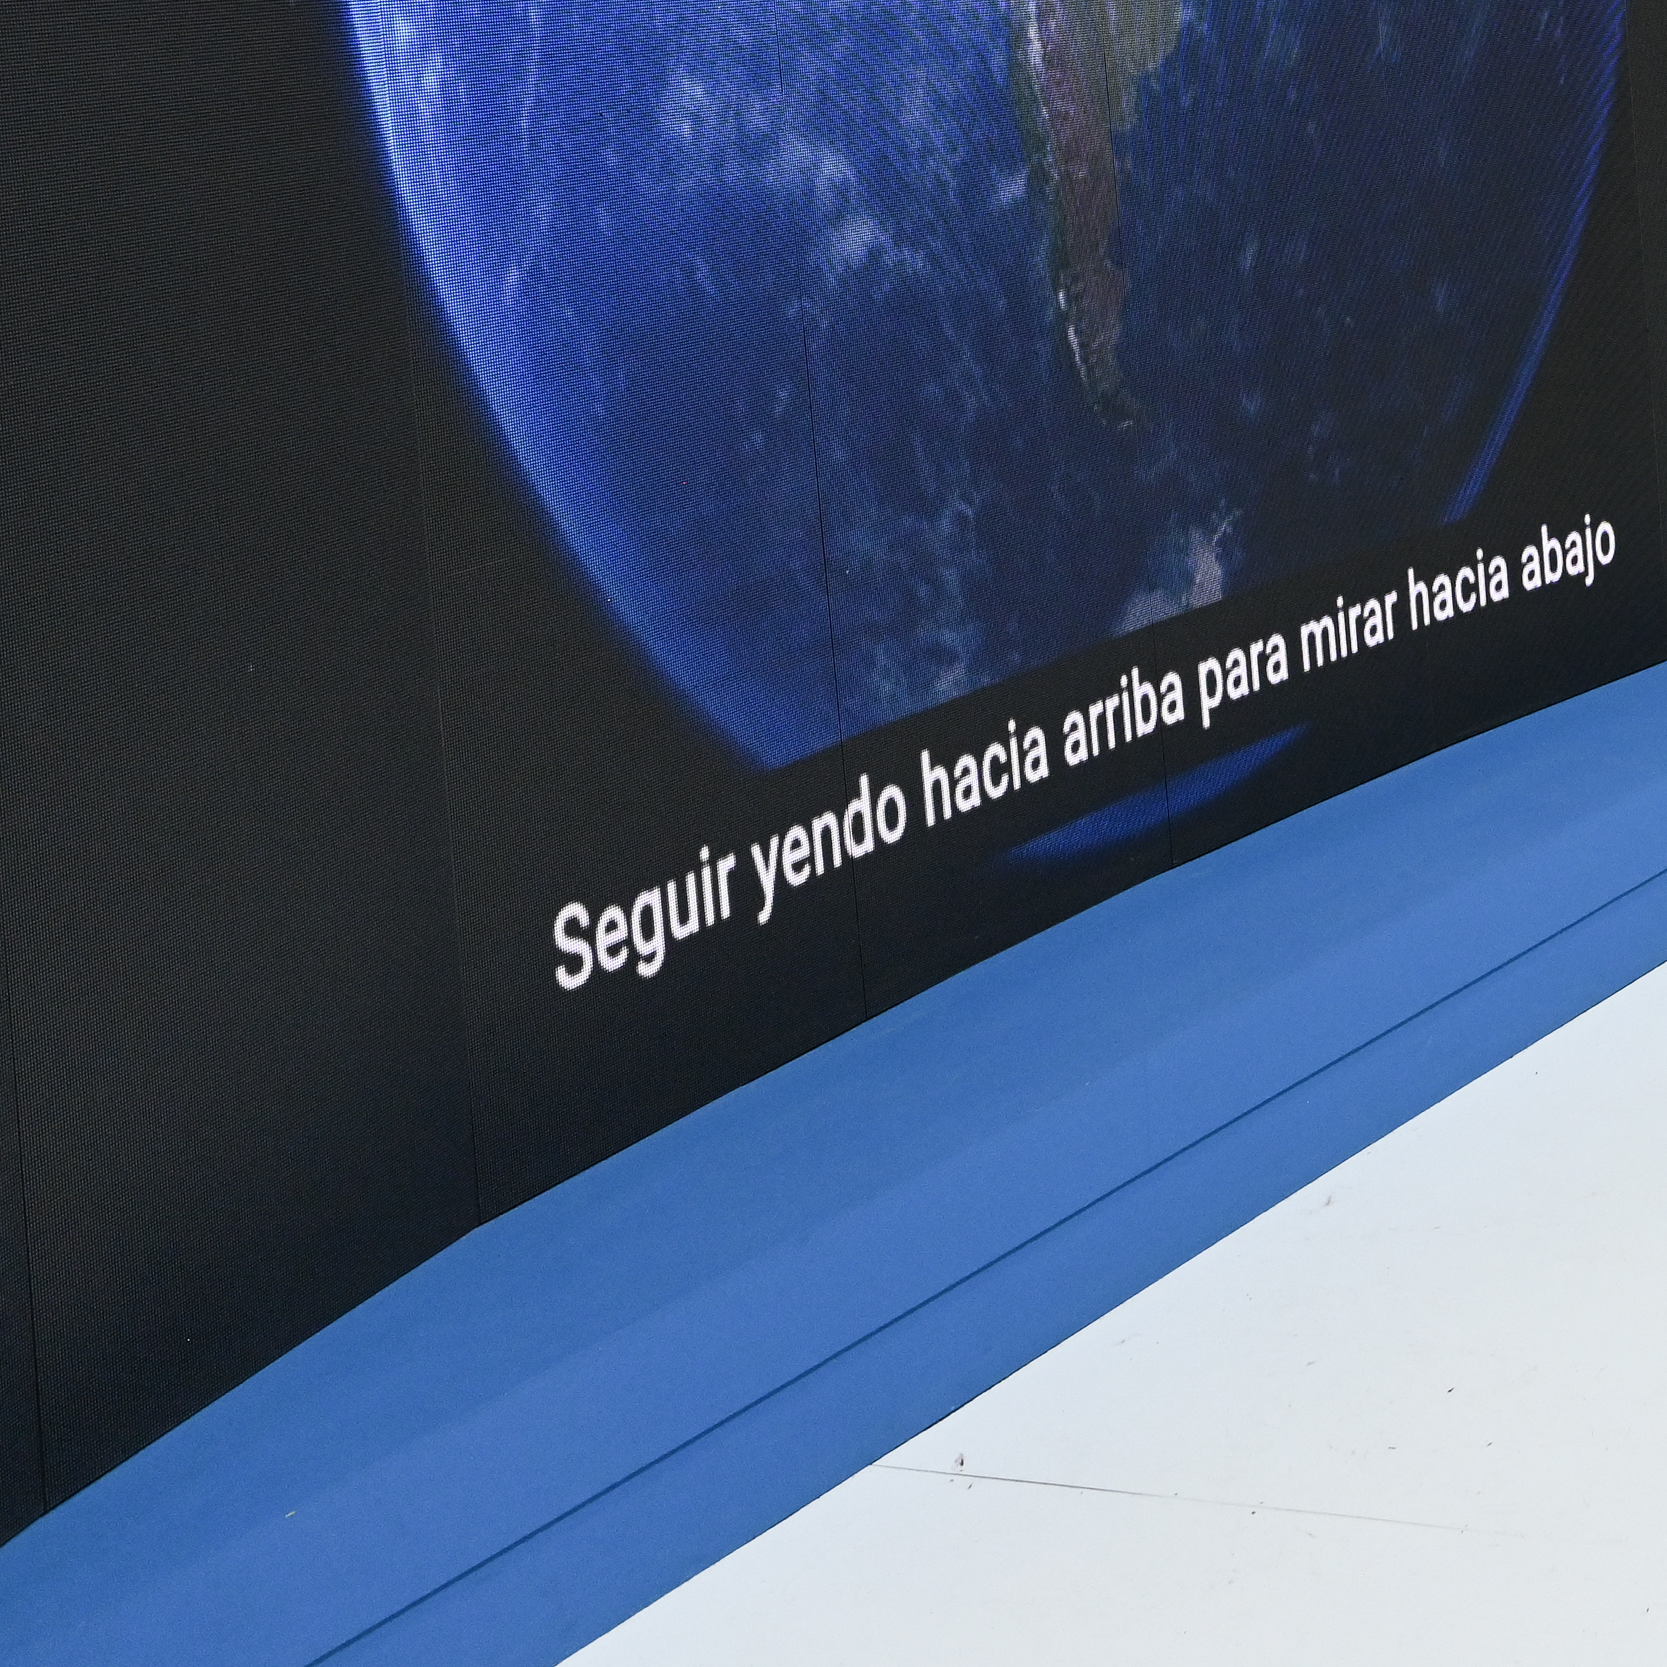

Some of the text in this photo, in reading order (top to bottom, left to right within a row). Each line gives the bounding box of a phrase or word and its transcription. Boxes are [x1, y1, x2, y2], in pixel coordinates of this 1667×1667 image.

[553, 515, 1616, 990] Seguir yendo hacia arriba para mirar hacia abajo
